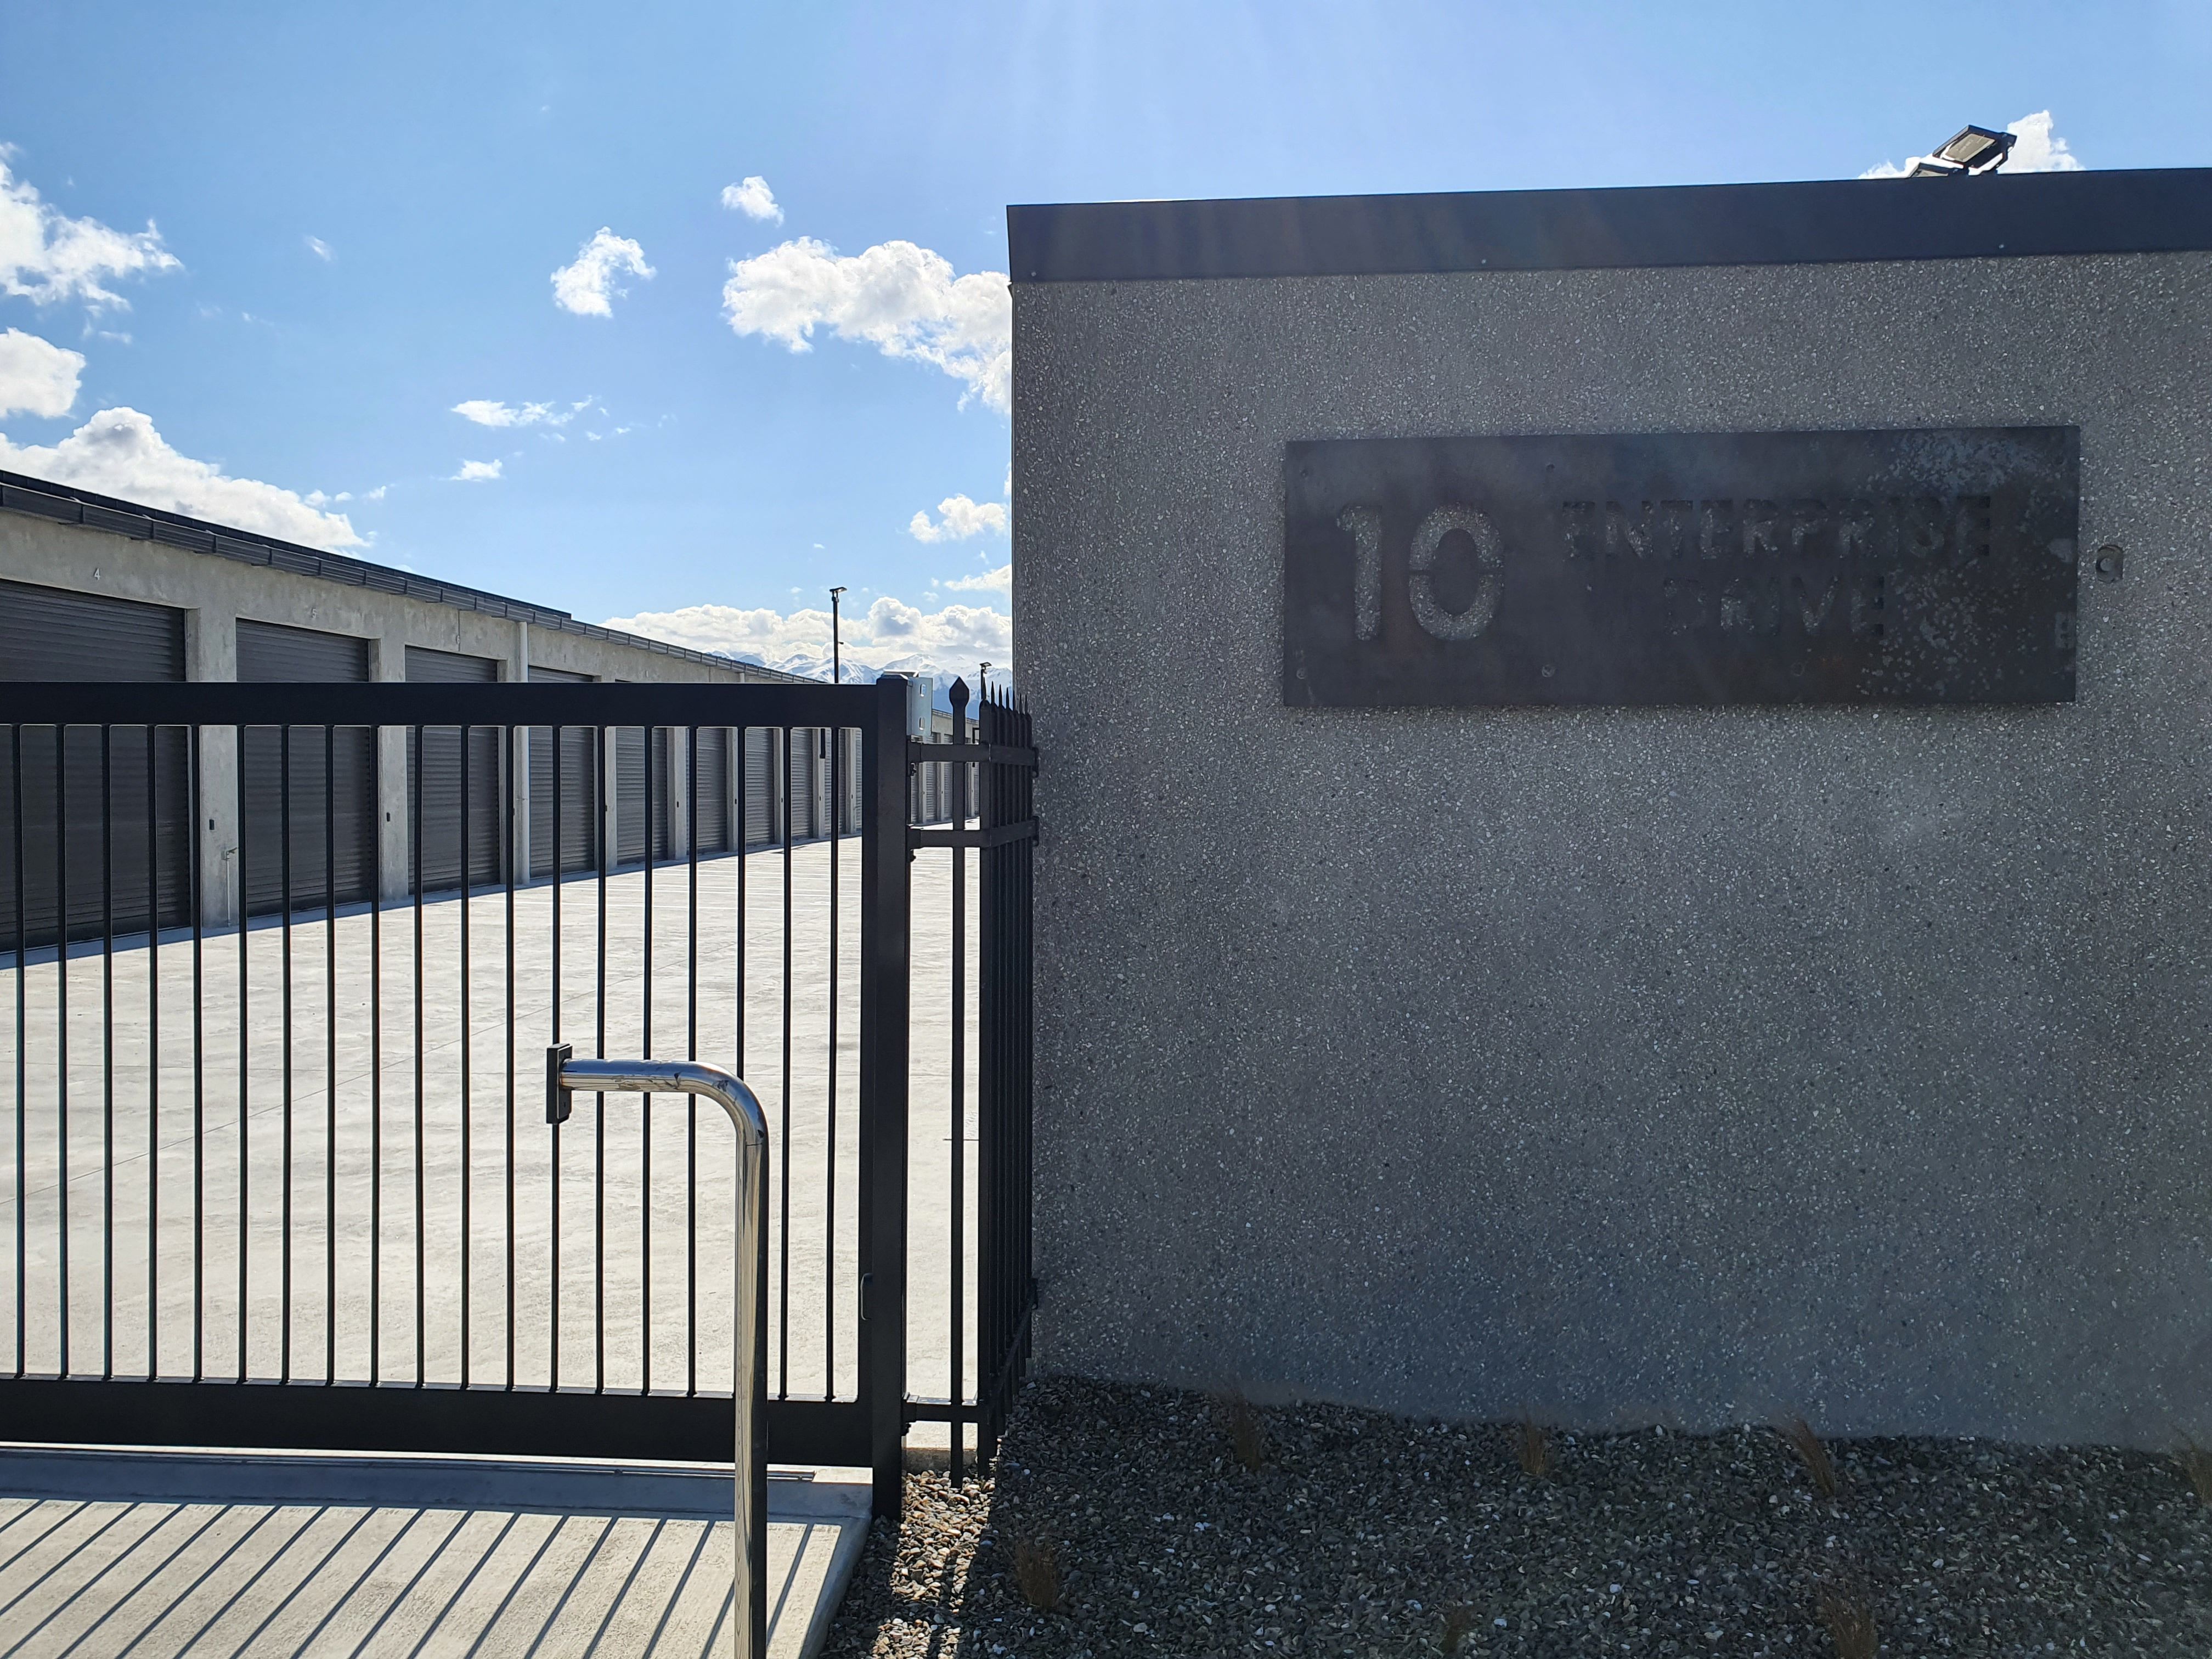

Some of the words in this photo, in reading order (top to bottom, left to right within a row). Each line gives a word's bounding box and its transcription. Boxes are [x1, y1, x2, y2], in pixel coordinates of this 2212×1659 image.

[1562, 497, 1990, 560] ENTERPRISE
[94, 567, 100, 580] 4
[1336, 499, 1504, 641] 10
[312, 608, 317, 619] 5
[1663, 575, 1885, 636] DRIVE
